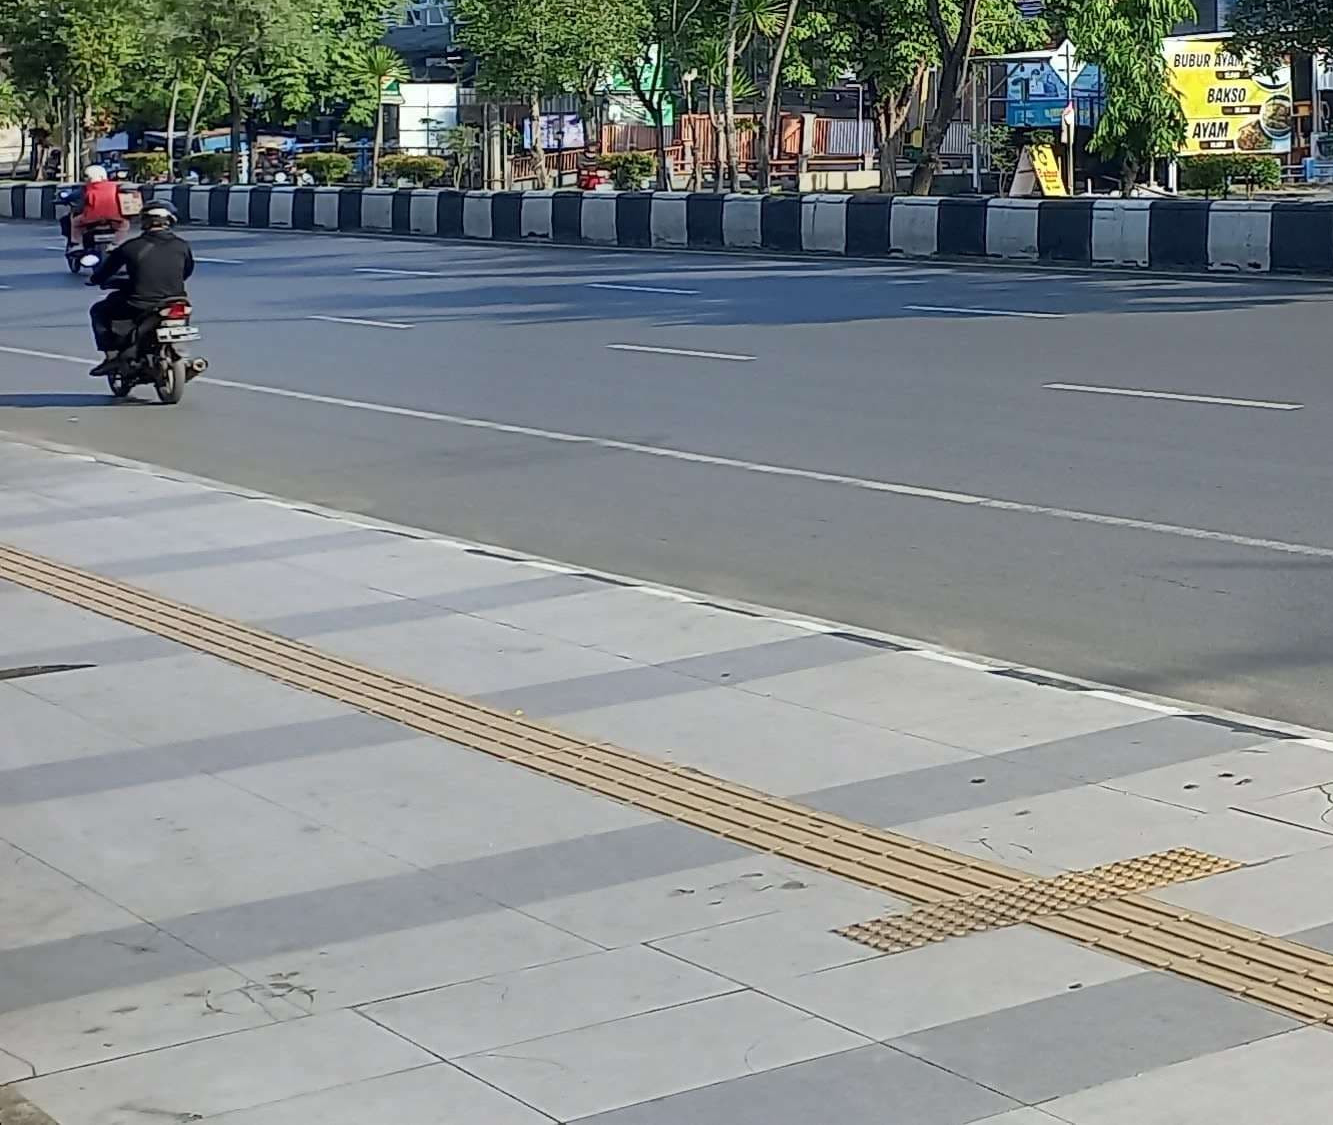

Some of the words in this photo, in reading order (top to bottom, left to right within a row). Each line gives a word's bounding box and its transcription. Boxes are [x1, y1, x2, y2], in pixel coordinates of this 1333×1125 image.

[1174, 54, 1210, 67] BUBUR
[1207, 87, 1246, 103] BAKSO
[1192, 121, 1229, 139] AYAM
